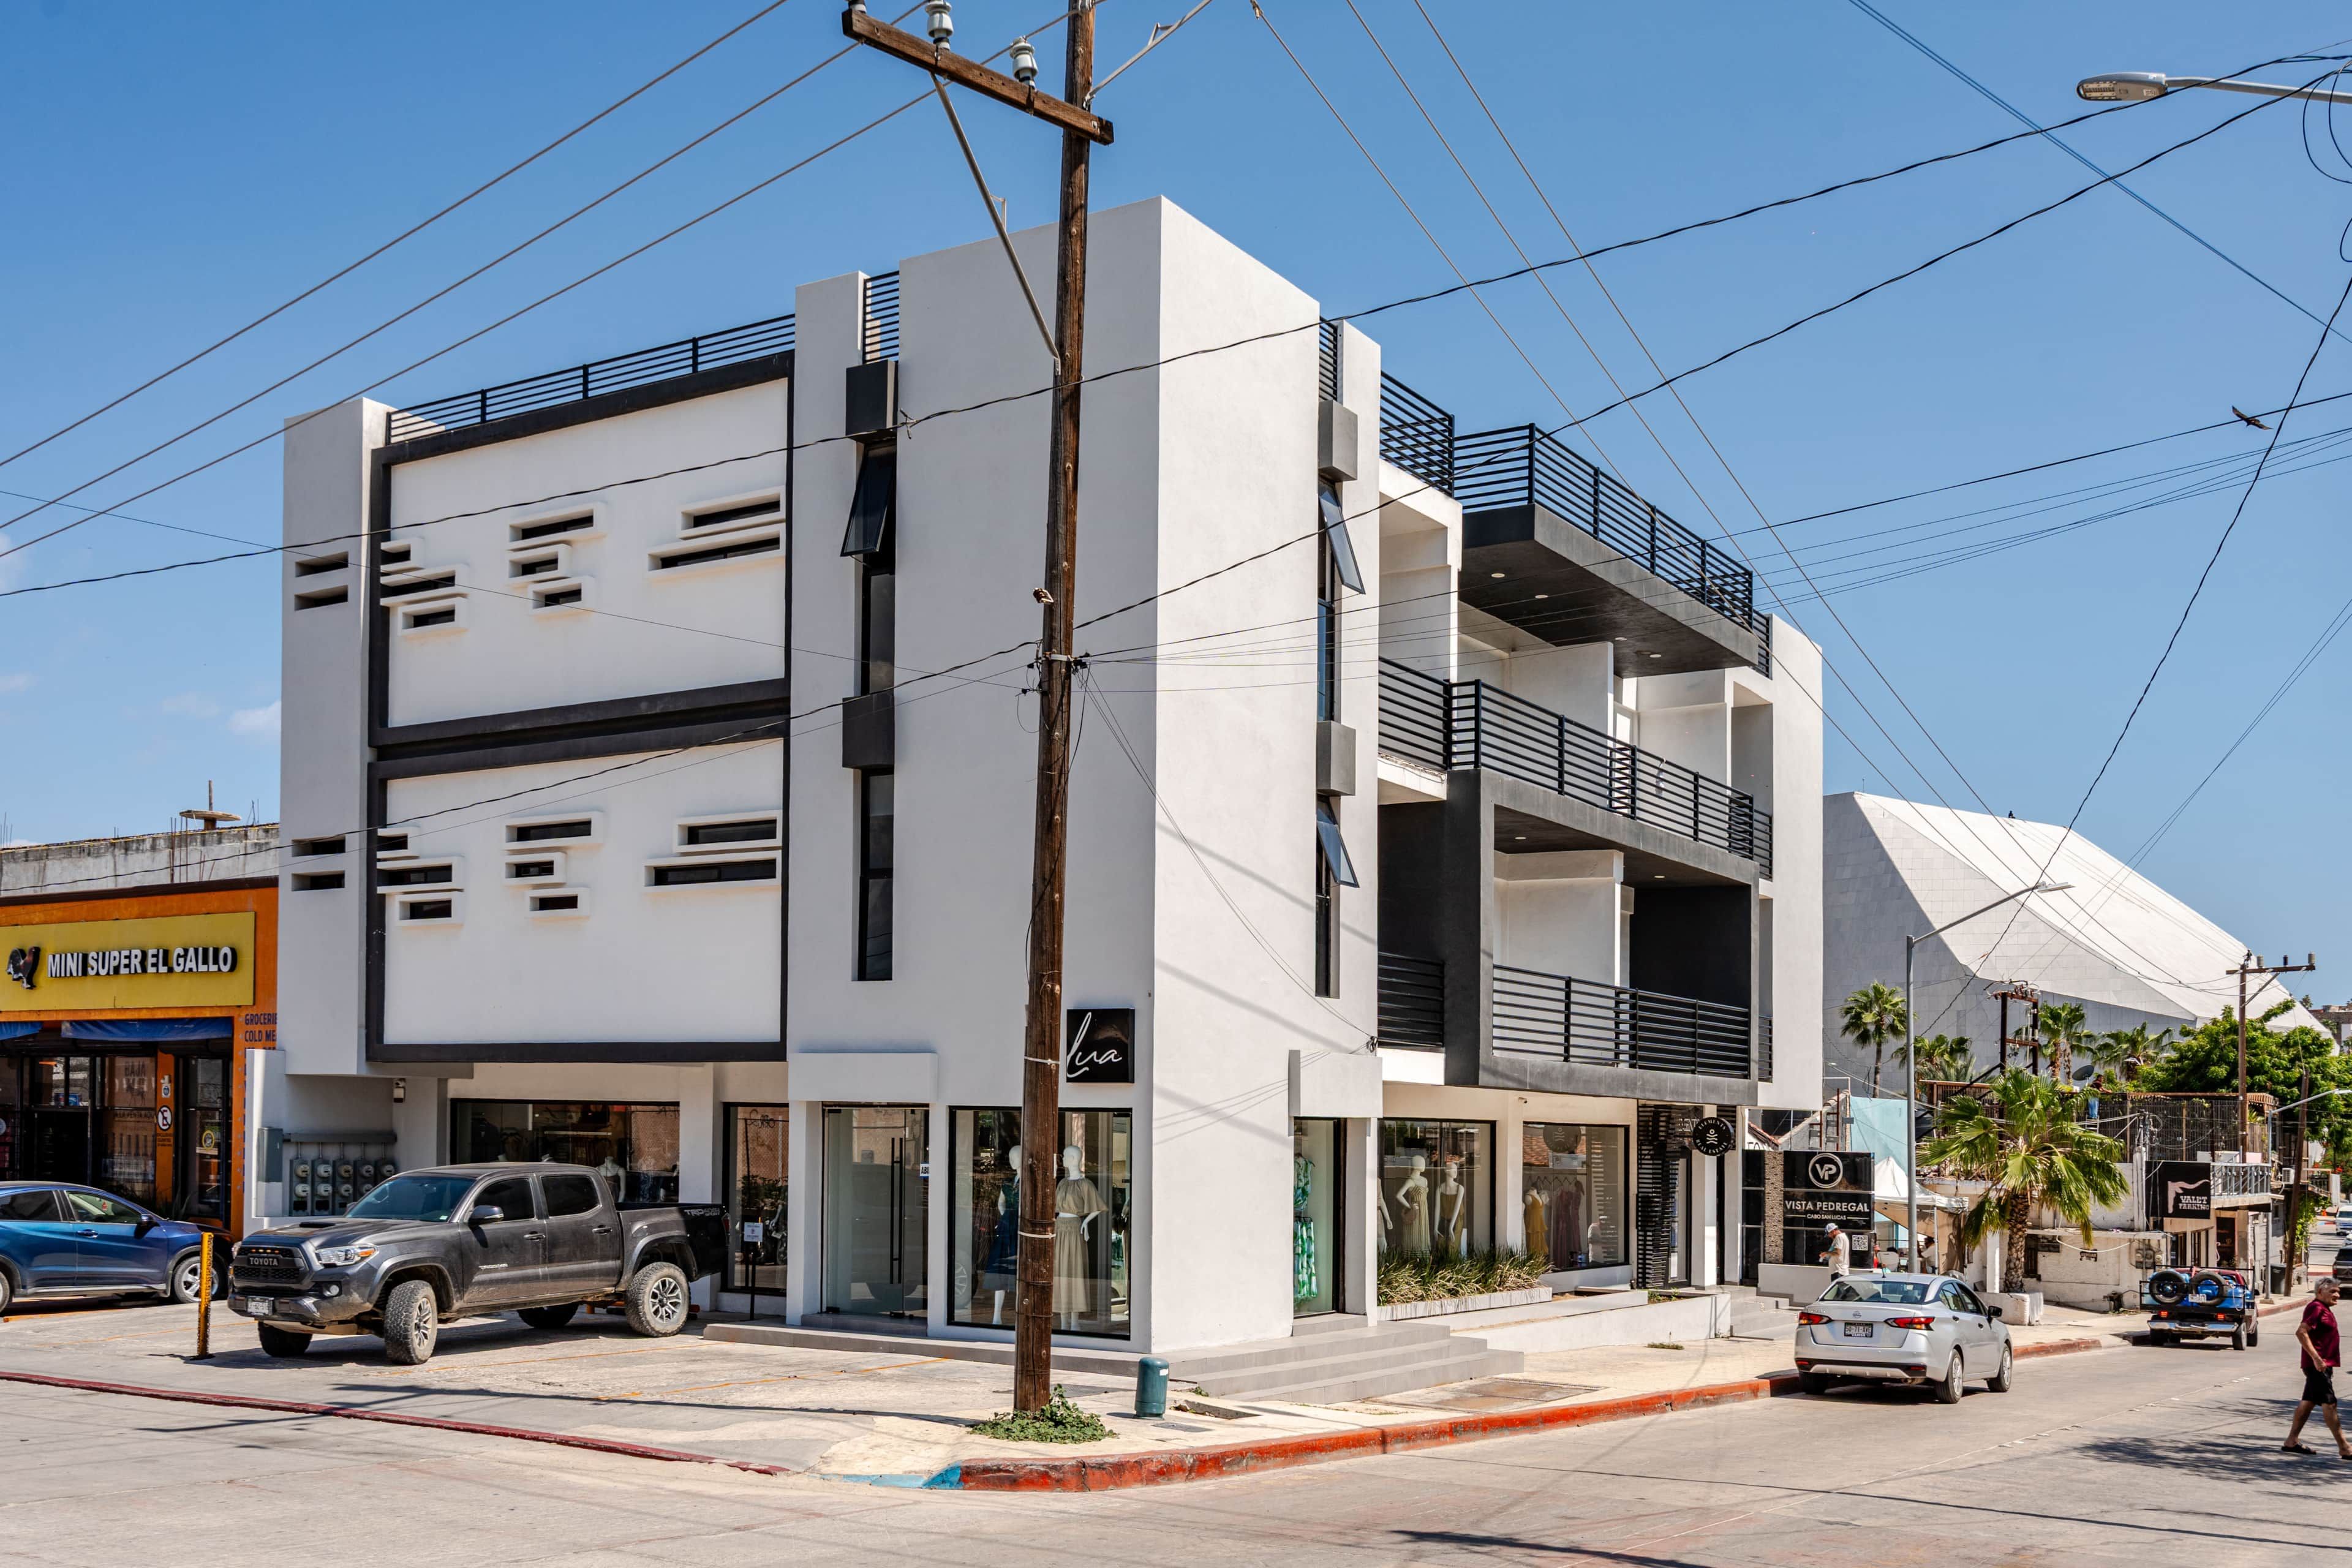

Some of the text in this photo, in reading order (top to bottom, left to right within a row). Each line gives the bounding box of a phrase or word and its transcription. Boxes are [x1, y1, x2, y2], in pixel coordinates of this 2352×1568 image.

[48, 947, 233, 978] MINI SUPER EL GALLO
[245, 1030, 263, 1042] COLD
[1695, 1139, 1706, 1152] REAL
[1708, 1142, 1728, 1153] ESTATE
[1785, 1200, 1870, 1212] VISTA PEDREGAL
[249, 1257, 279, 1266] TOYOTA
